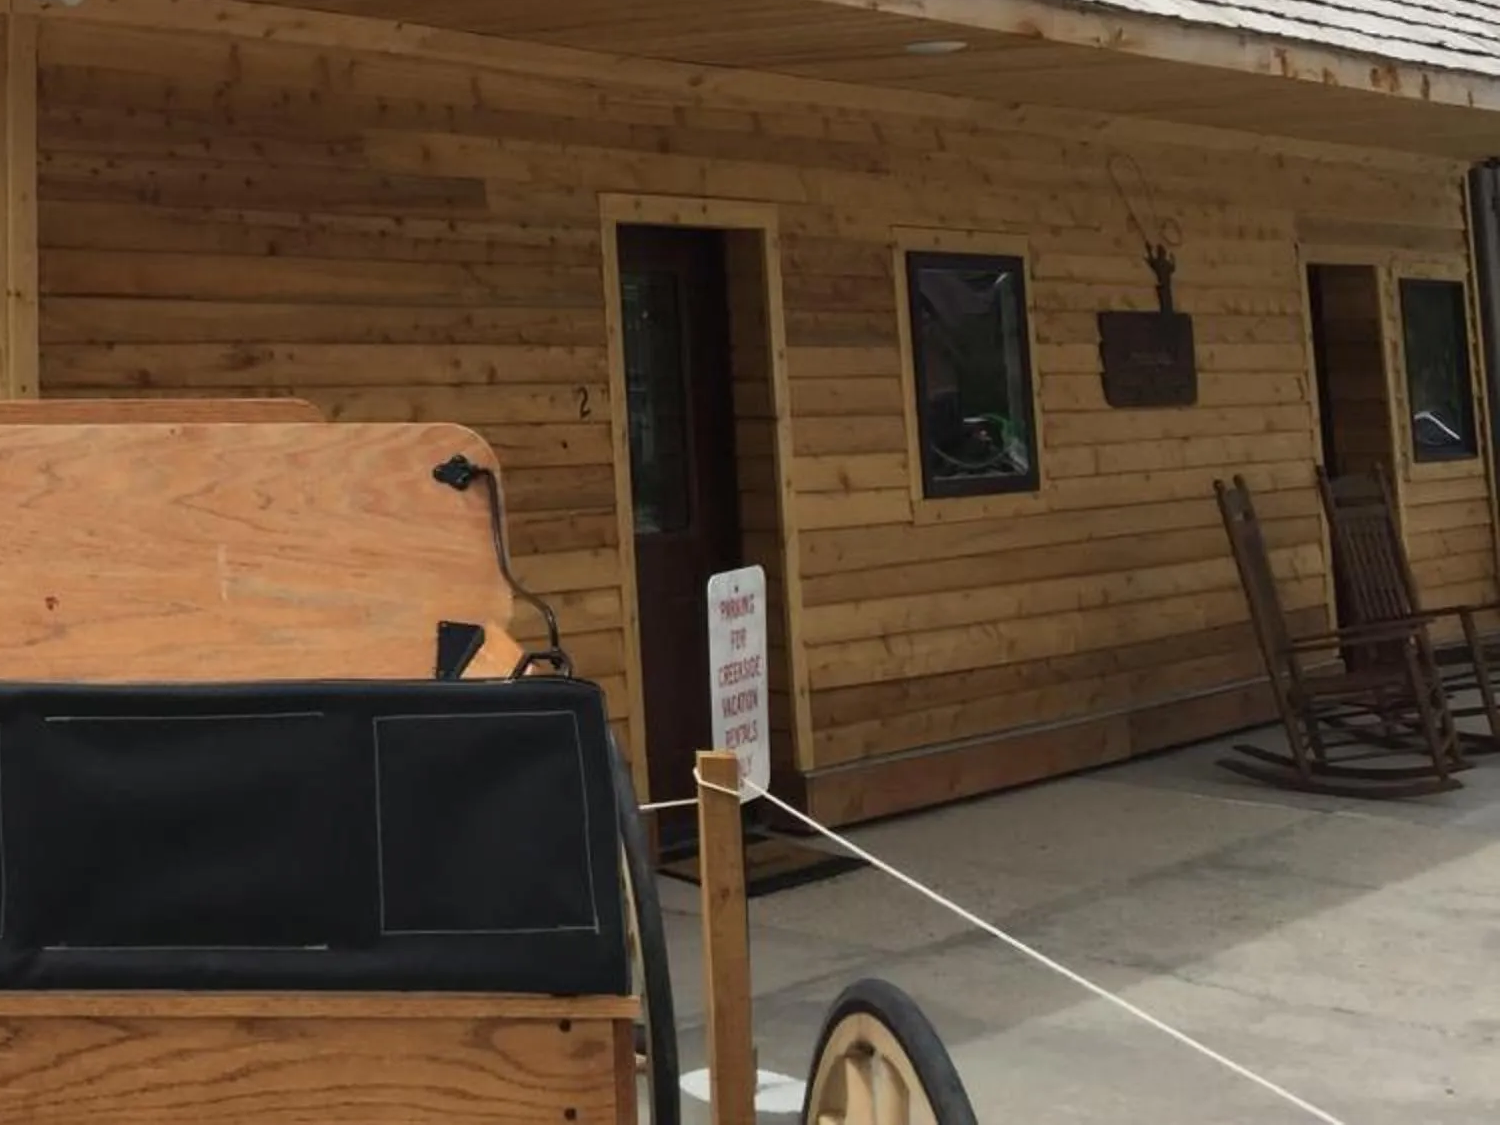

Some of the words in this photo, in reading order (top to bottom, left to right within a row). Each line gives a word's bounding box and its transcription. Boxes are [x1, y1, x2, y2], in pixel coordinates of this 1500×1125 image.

[577, 386, 591, 419] 2
[719, 593, 756, 619] PARKING
[730, 627, 747, 651] FOR
[718, 655, 763, 688] CREEKSIDE
[721, 689, 758, 718] VACATION
[725, 720, 758, 749] RENTALS
